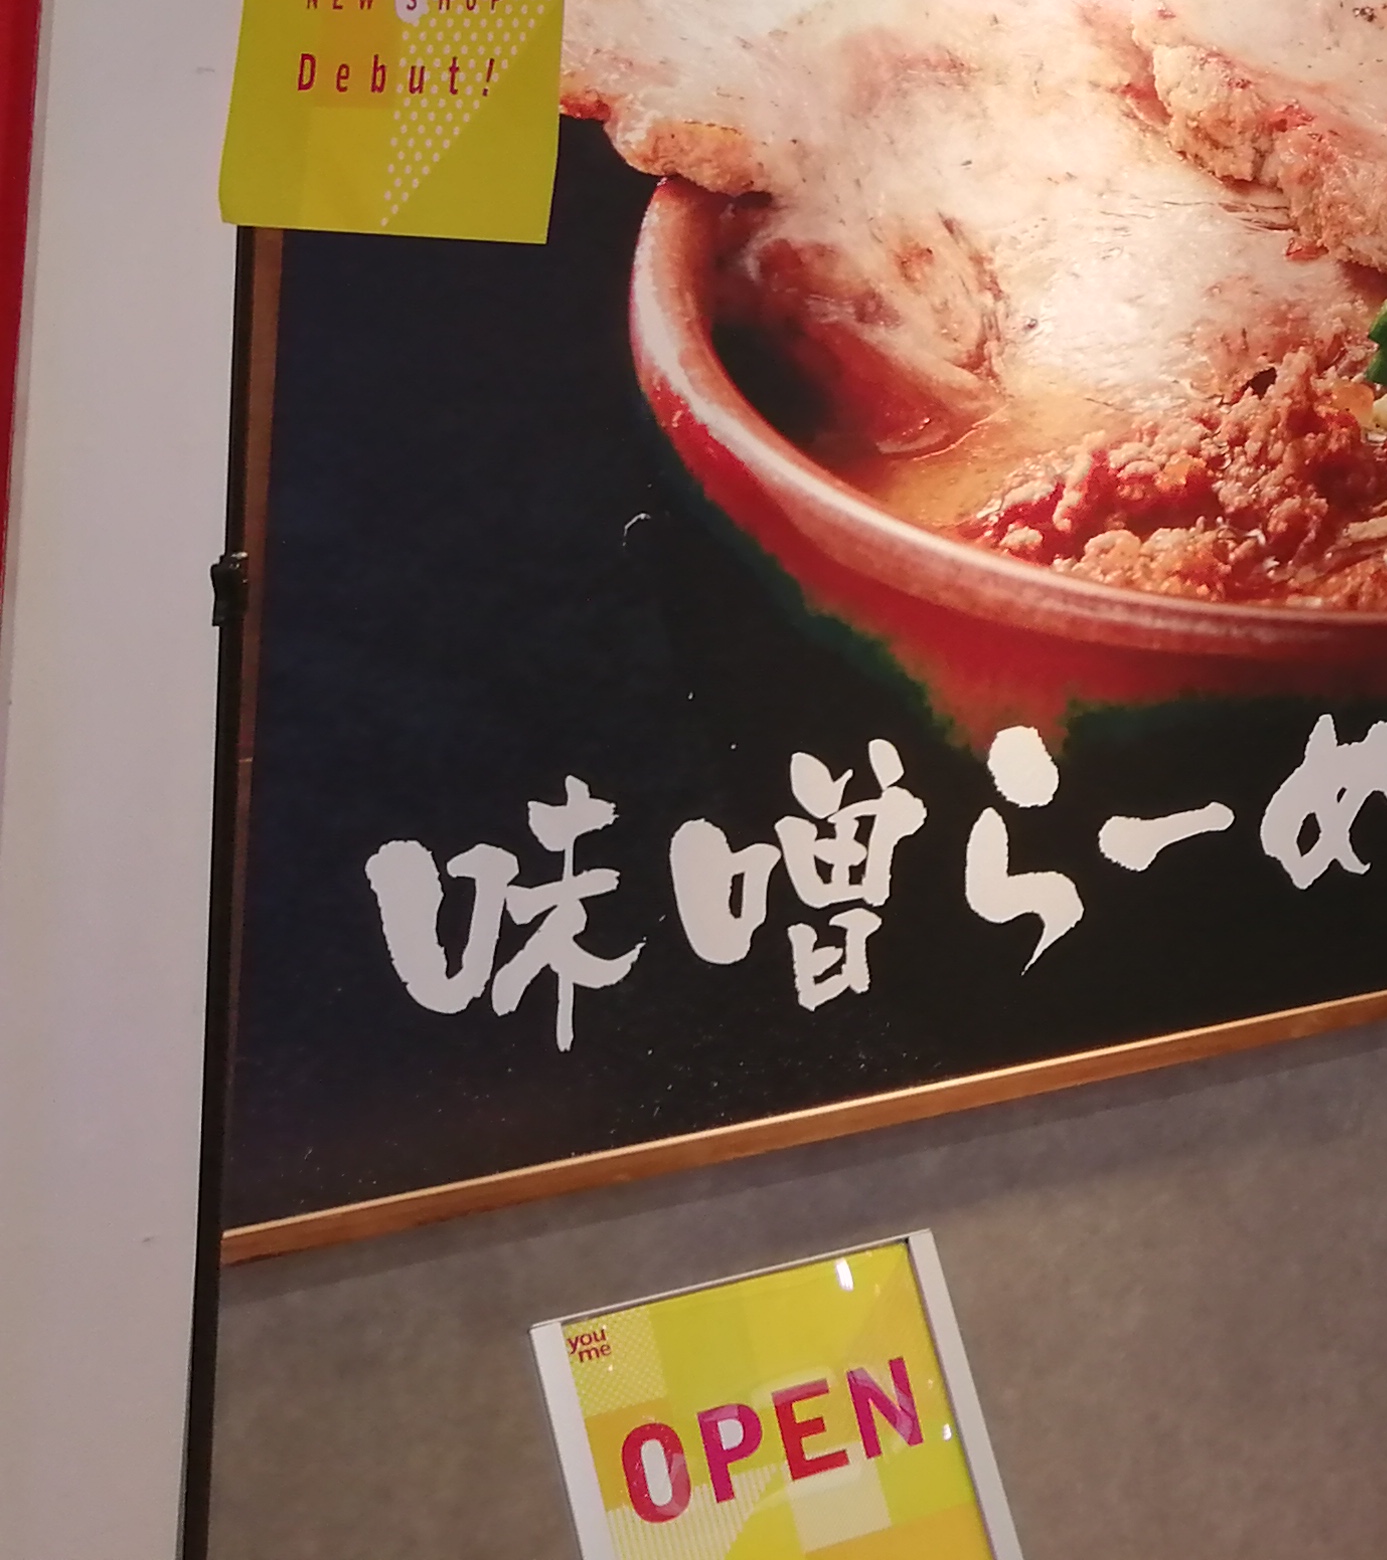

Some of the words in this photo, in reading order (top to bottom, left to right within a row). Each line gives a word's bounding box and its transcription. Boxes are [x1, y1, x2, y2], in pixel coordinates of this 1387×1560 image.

[297, 53, 495, 97] Debut!
[567, 1327, 607, 1356] you
[578, 1342, 612, 1363] me
[620, 1356, 925, 1525] OPEN
